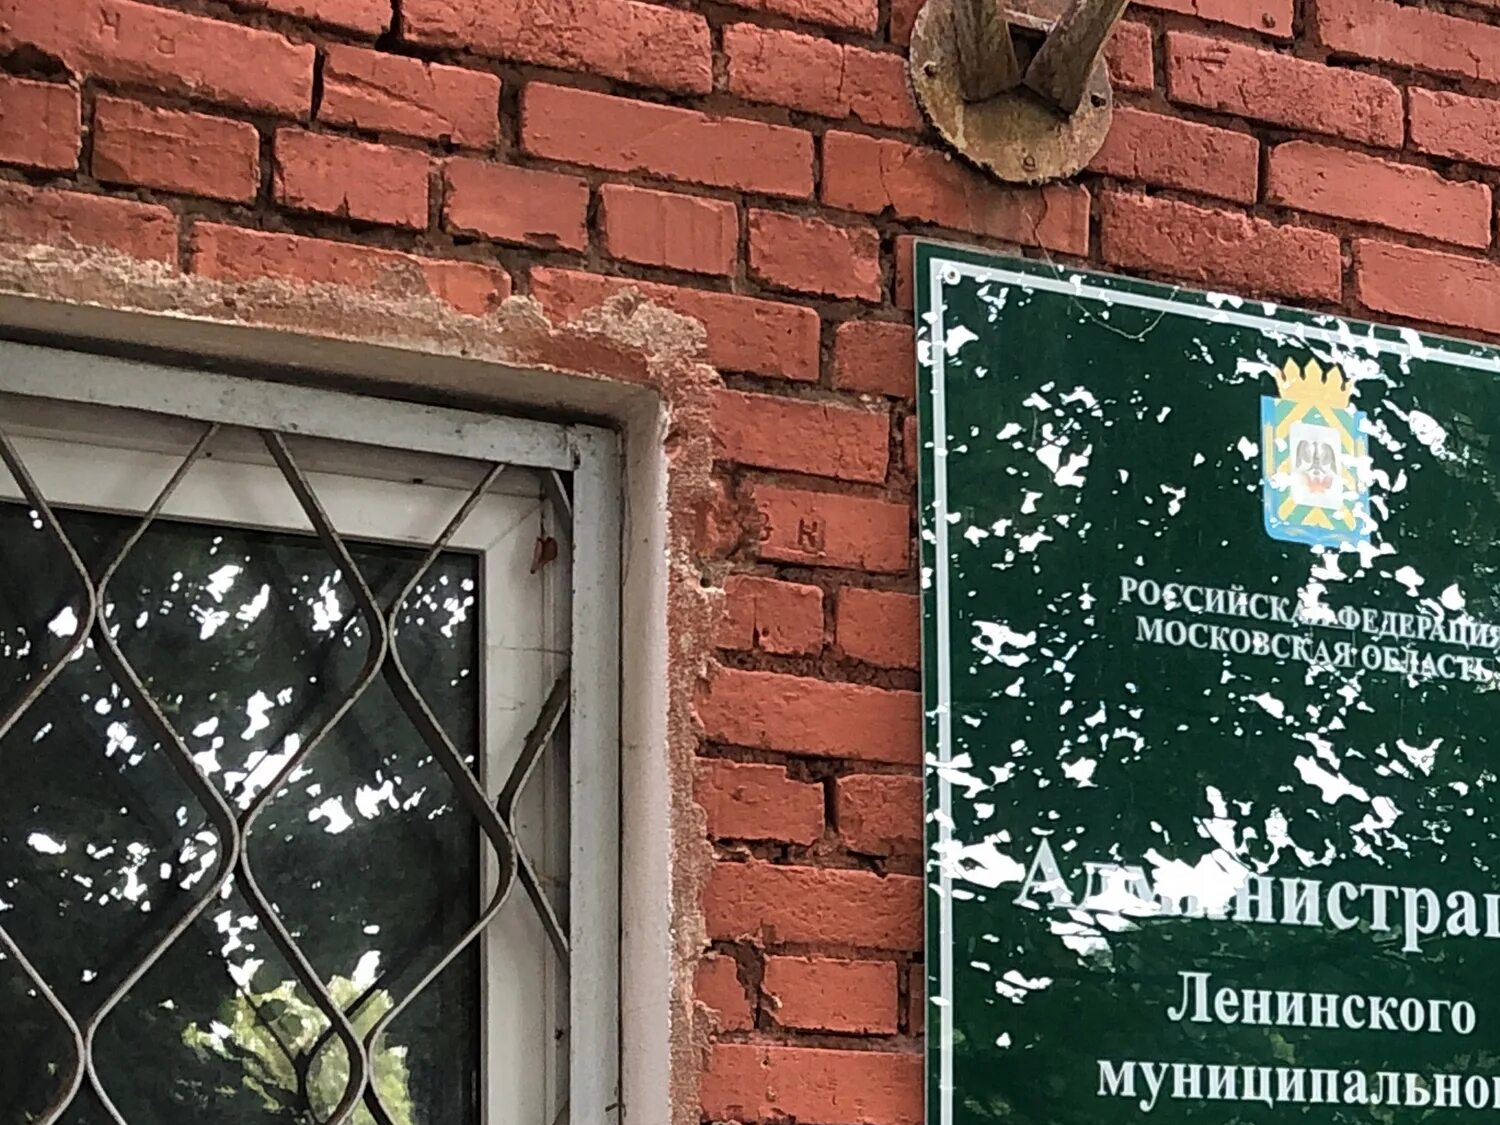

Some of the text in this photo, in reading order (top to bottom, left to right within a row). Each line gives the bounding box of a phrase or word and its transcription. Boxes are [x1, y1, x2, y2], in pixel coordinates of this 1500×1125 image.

[1118, 574, 1332, 627] РОССИЙСКА
[1135, 616, 1493, 683] МОСКОВСКАЯ ОБЛАСТЬ
[1167, 971, 1476, 1034] Ленинского
